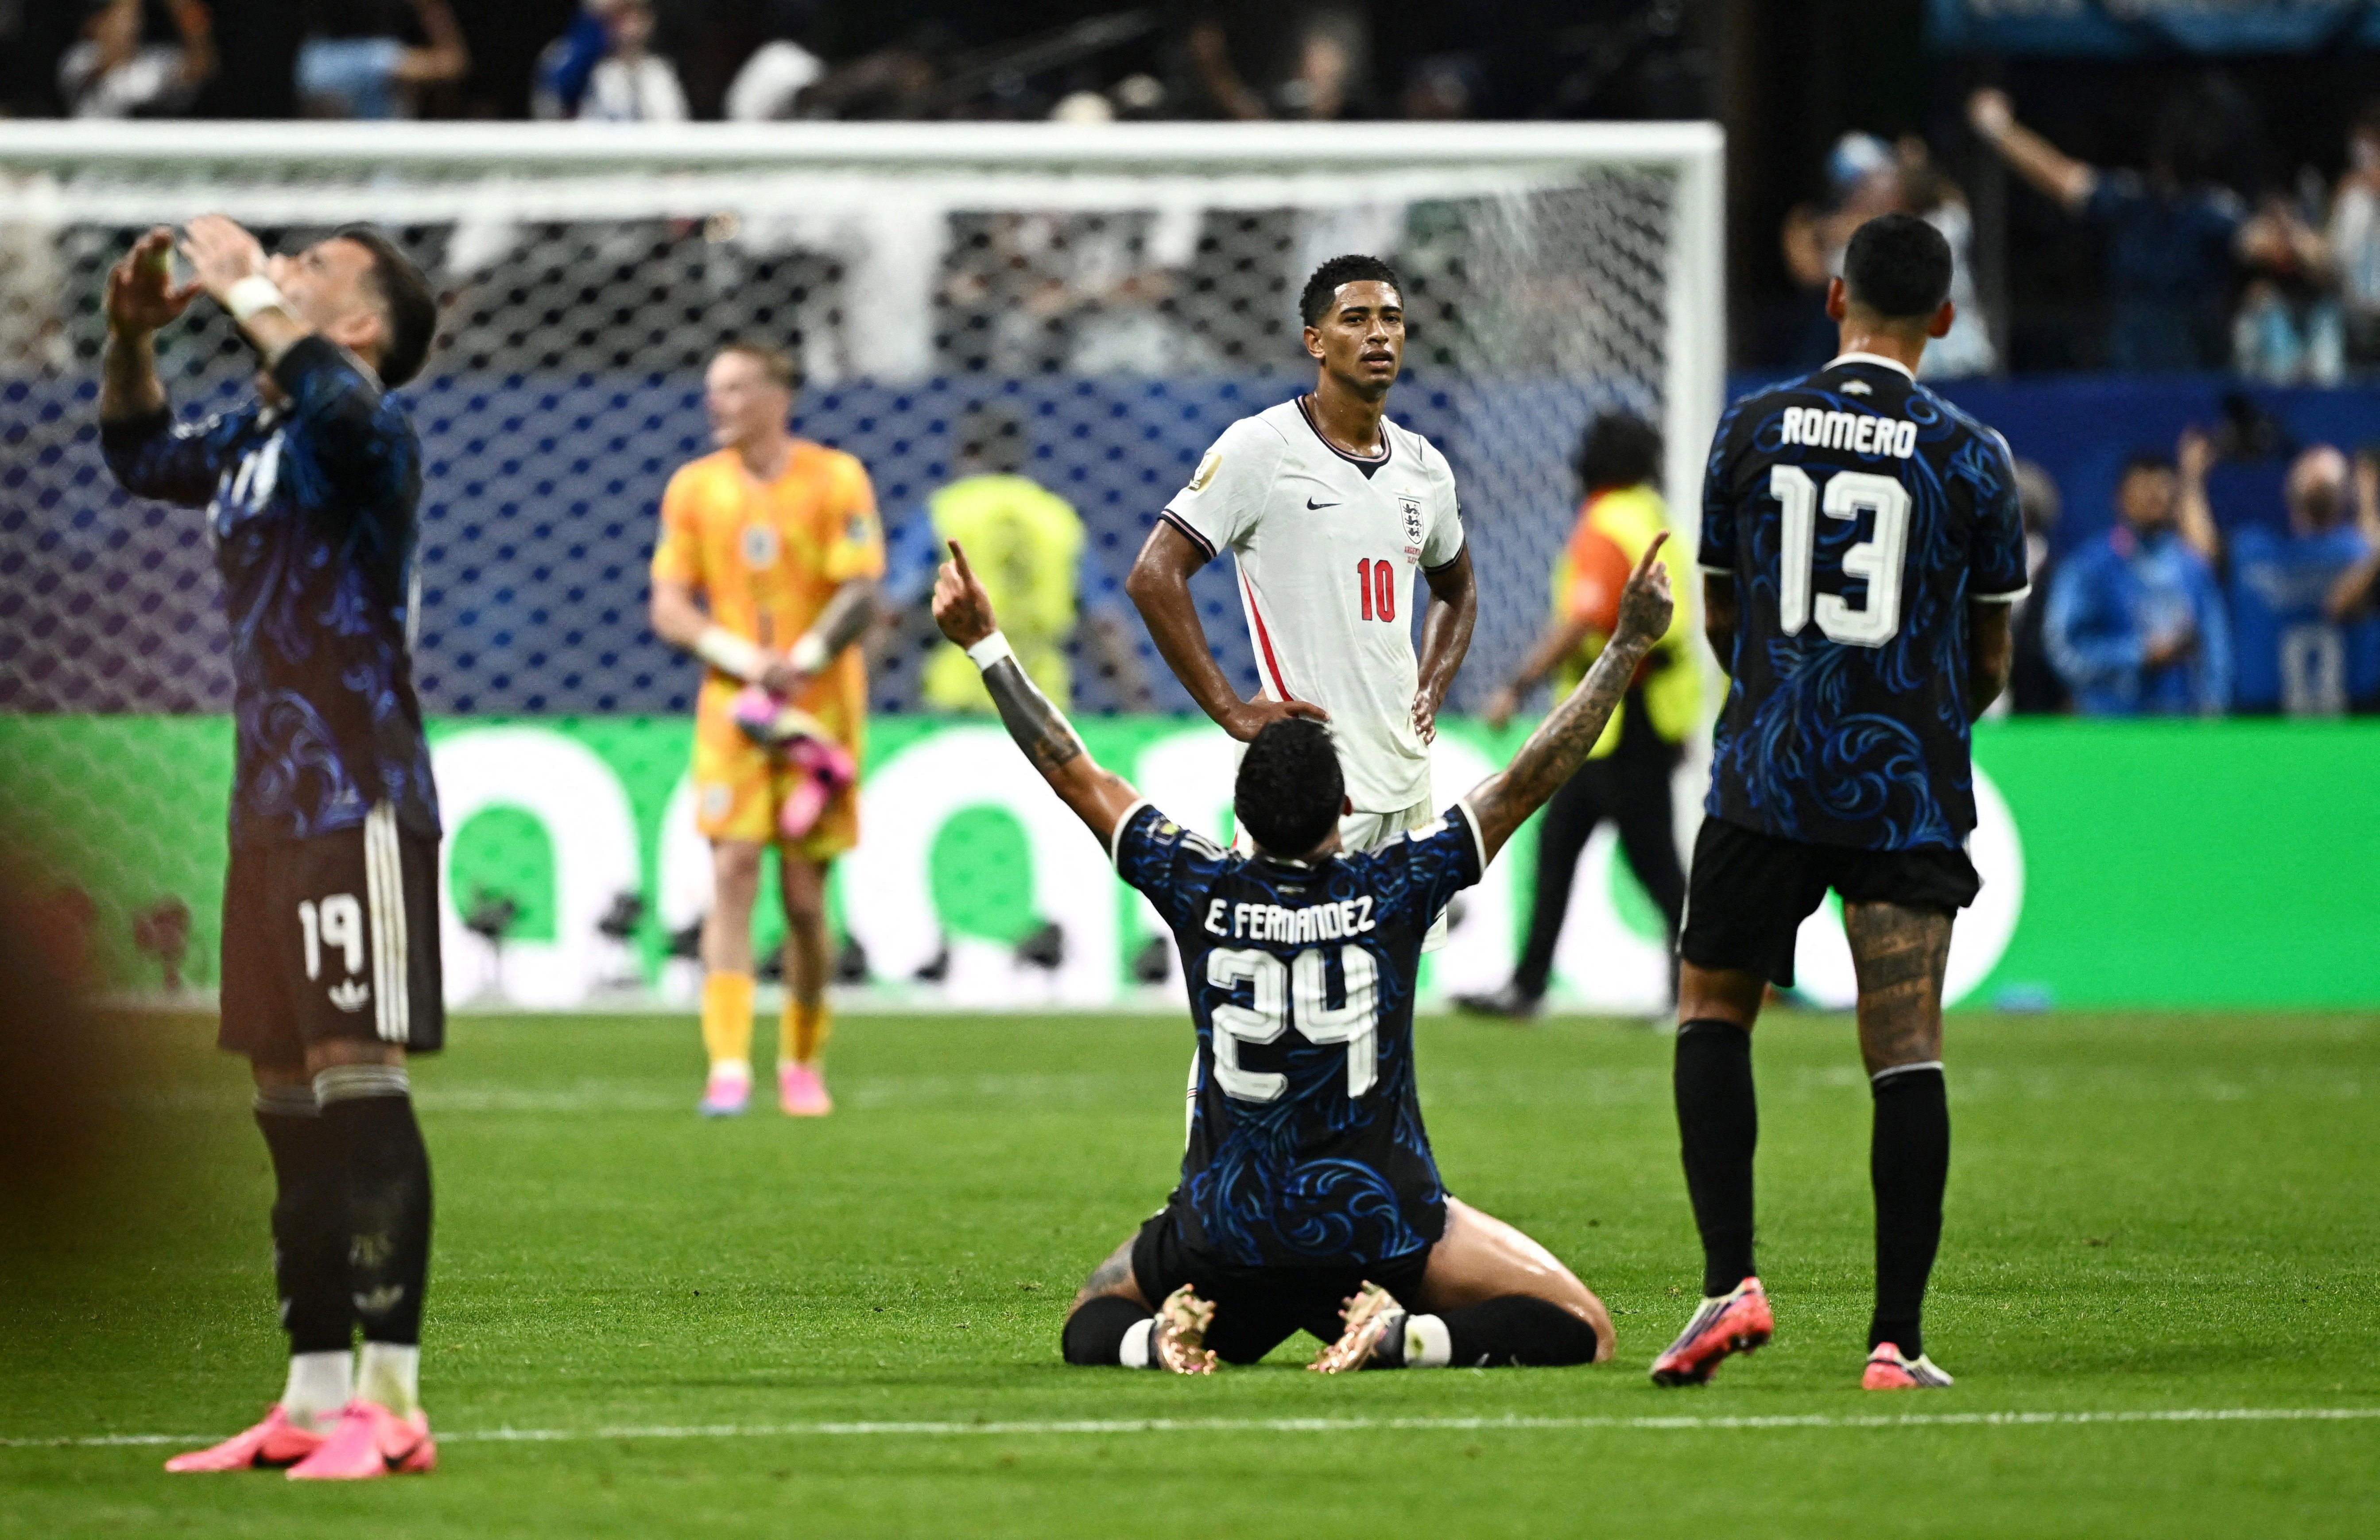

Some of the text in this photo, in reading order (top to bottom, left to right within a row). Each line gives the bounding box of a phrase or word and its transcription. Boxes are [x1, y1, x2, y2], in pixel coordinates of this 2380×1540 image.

[1782, 406, 1918, 459] ROMERO
[1357, 557, 1395, 623] 10
[1770, 464, 1912, 649] 13
[298, 893, 364, 982] 19
[1204, 895, 1376, 944] E. FERNANDEZ
[1207, 943, 1379, 1104] 24
